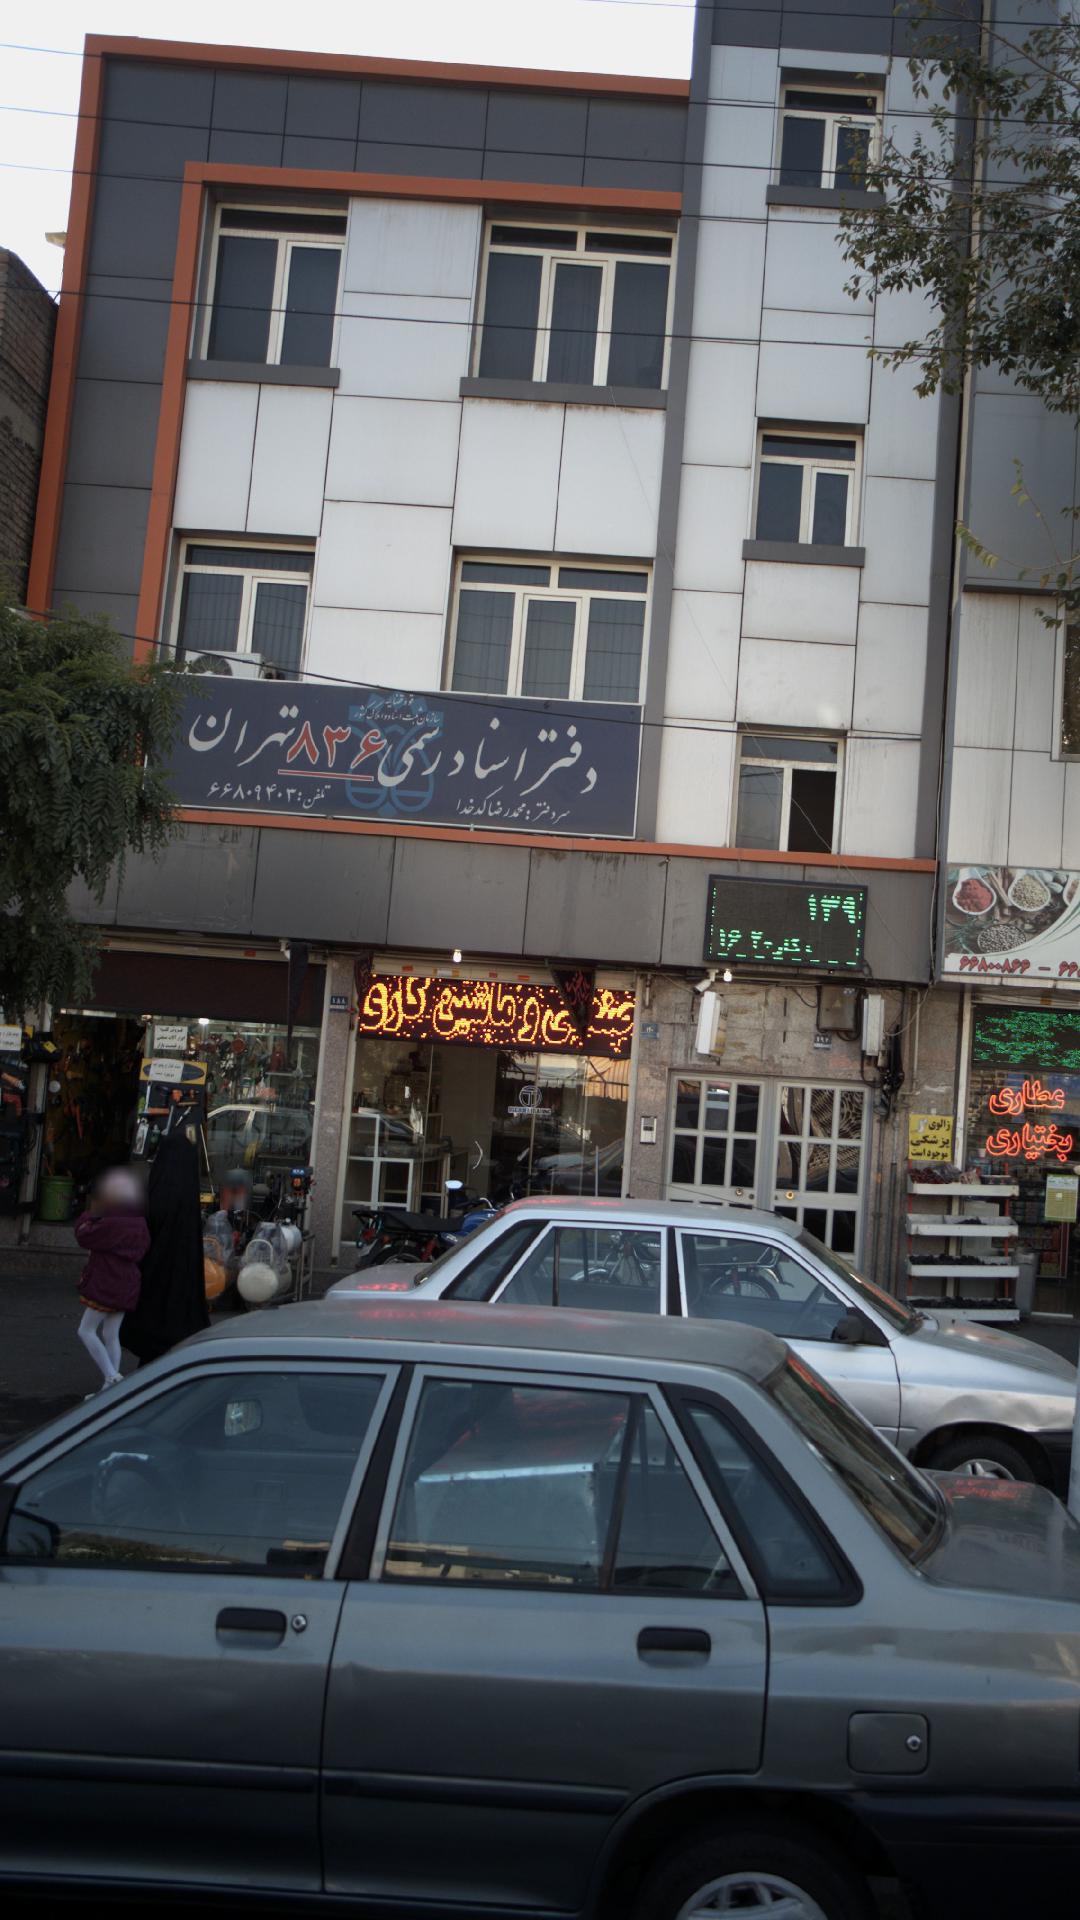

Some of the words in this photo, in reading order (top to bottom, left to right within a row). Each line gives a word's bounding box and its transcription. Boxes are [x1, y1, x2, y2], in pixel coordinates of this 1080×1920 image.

[187, 703, 299, 768] تهران
[284, 719, 388, 768] ۸۳۶
[377, 722, 442, 788] رسمی
[448, 716, 526, 783] اسناد
[520, 724, 598, 796] دفتر
[928, 1119, 951, 1132] زالوی
[989, 1080, 1065, 1116] عطاری
[985, 1121, 1074, 1162] بختیاری
